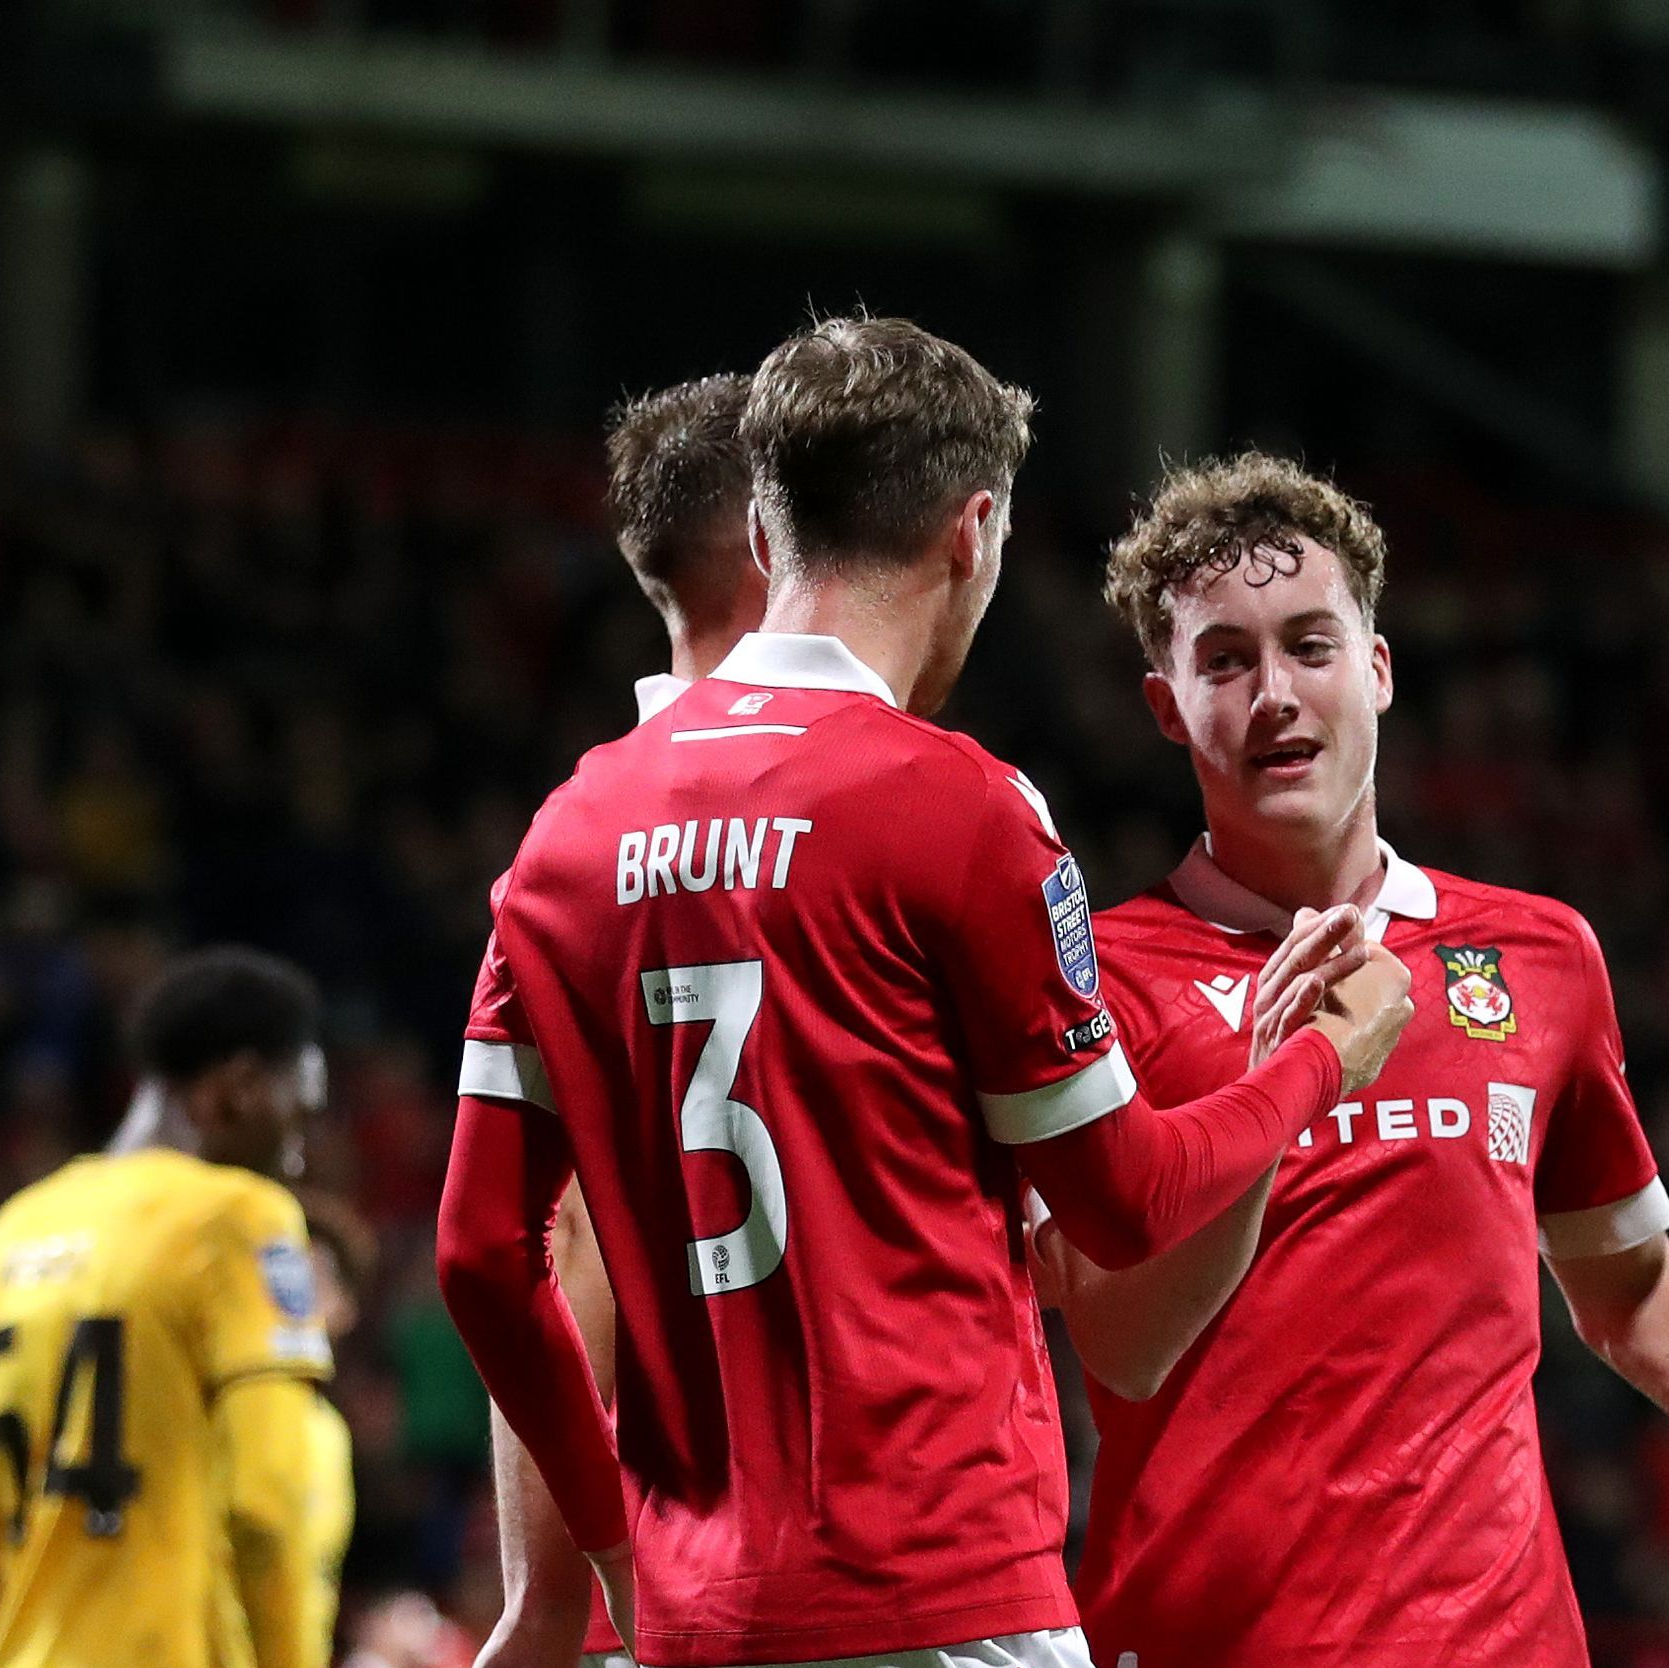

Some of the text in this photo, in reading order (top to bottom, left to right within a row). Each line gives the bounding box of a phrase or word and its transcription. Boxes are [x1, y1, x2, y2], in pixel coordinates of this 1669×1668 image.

[616, 816, 814, 906] BRUNT
[1051, 886, 1085, 922] BRISTOL
[1056, 904, 1085, 939] STREET
[1060, 923, 1087, 953] MOTORS
[1063, 937, 1089, 967] TROPHY
[640, 959, 788, 1297] 3
[715, 1273, 731, 1285] EFL
